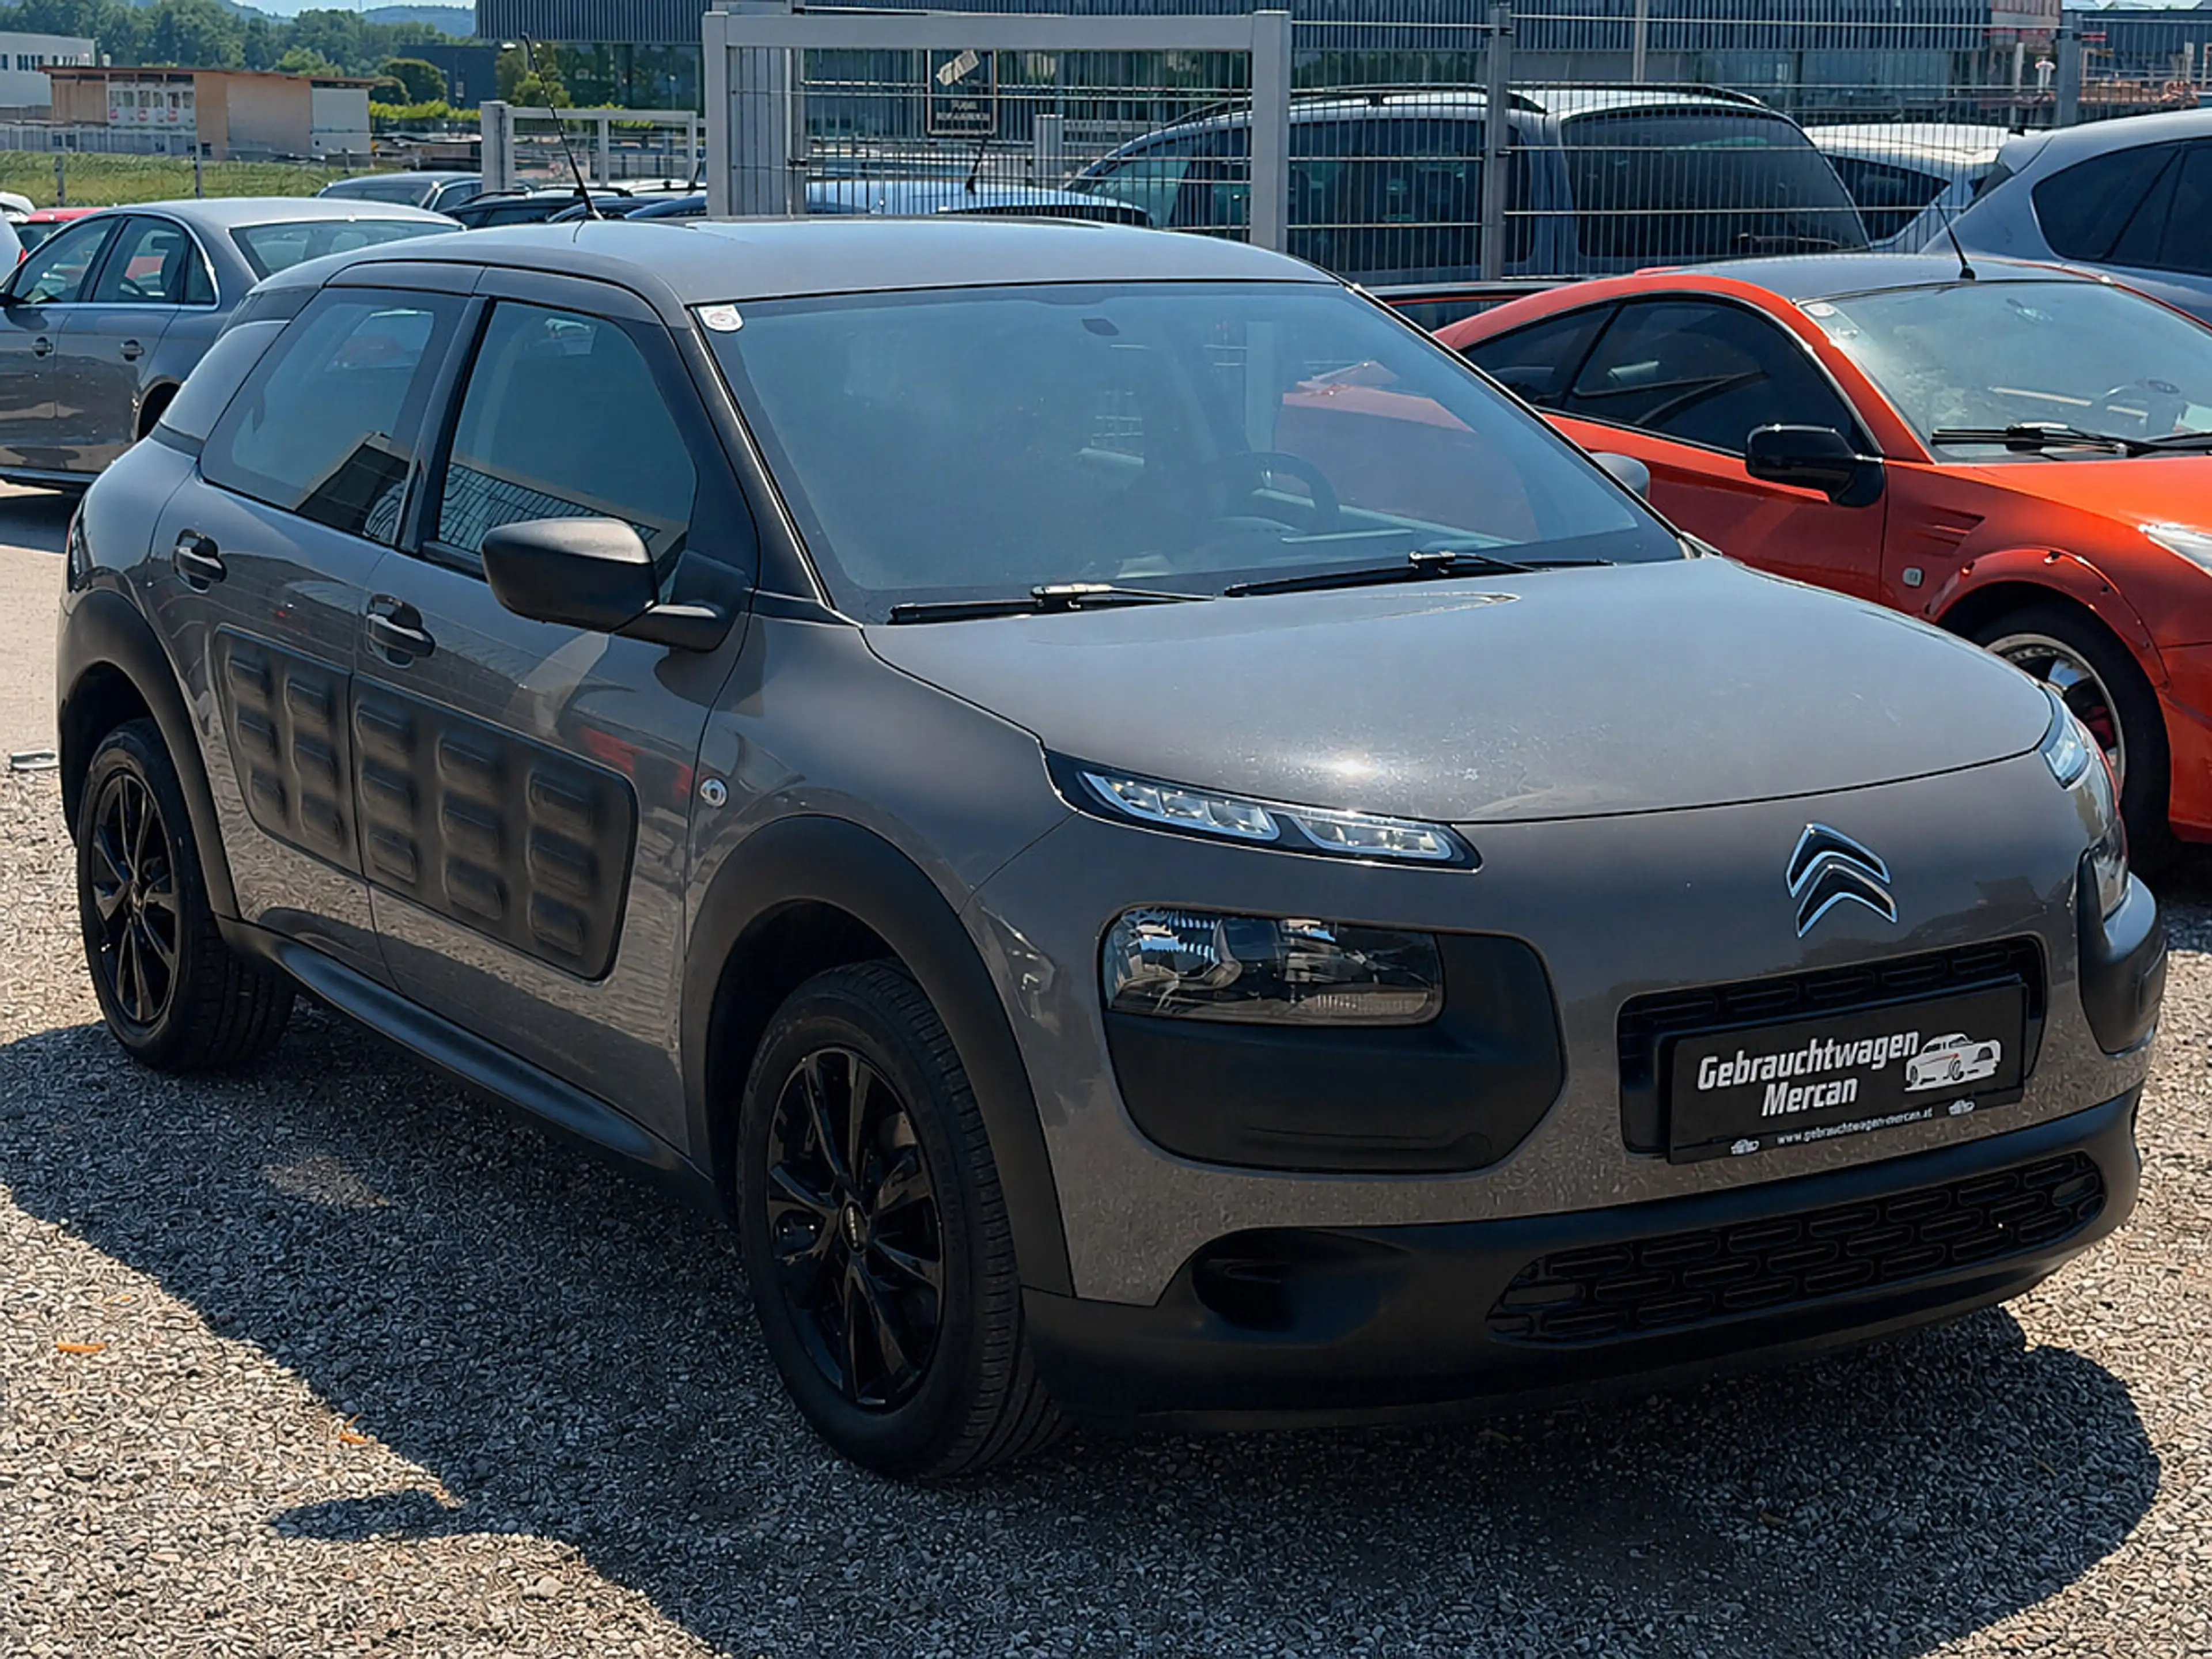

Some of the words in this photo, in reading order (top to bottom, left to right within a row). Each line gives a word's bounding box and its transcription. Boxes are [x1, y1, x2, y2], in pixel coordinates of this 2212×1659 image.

[1698, 1031, 1919, 1090] Gebrauchtwagen
[1762, 1078, 1858, 1116] Mercan
[1777, 1107, 1933, 1145] www.gebrauchtwagen-mercan.at
